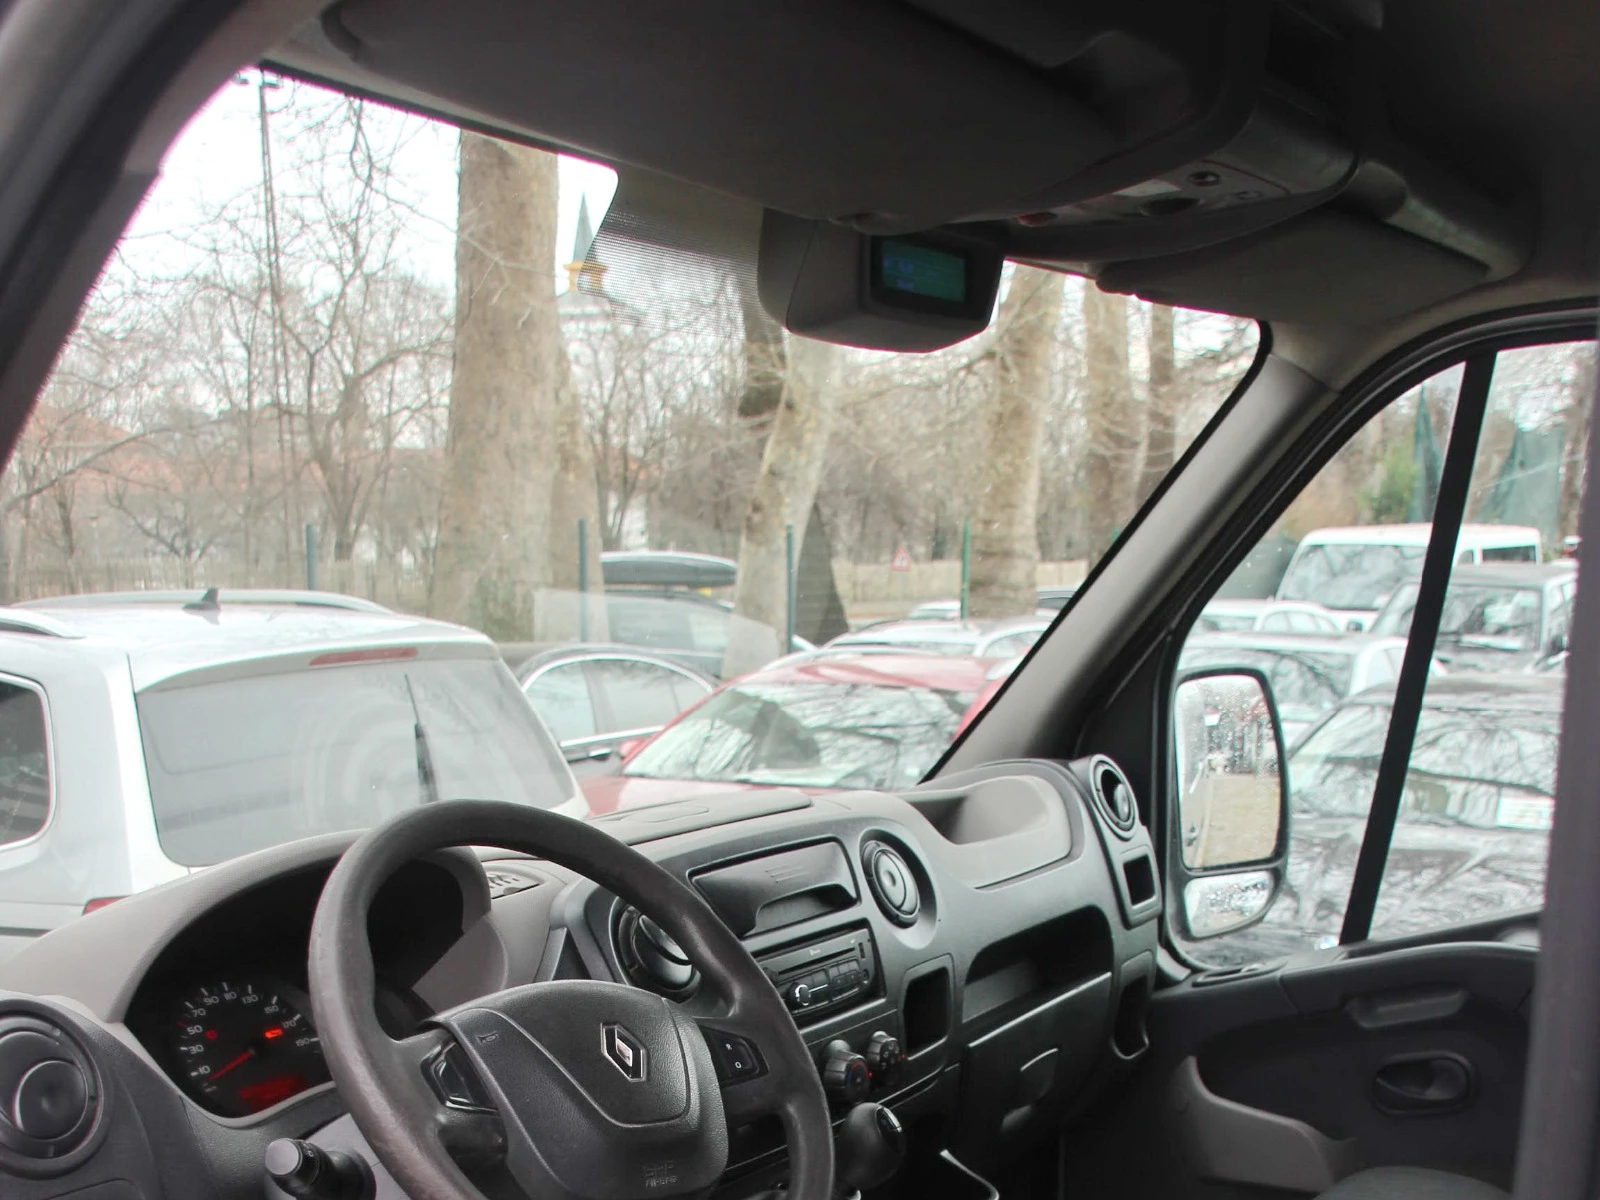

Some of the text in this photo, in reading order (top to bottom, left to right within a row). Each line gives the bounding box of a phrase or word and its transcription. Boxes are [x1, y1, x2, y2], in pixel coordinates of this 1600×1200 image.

[204, 995, 219, 1006] 90
[192, 1008, 206, 1018] 70
[187, 1025, 203, 1035] 50
[188, 1044, 204, 1055] 30
[198, 1065, 211, 1075] 10
